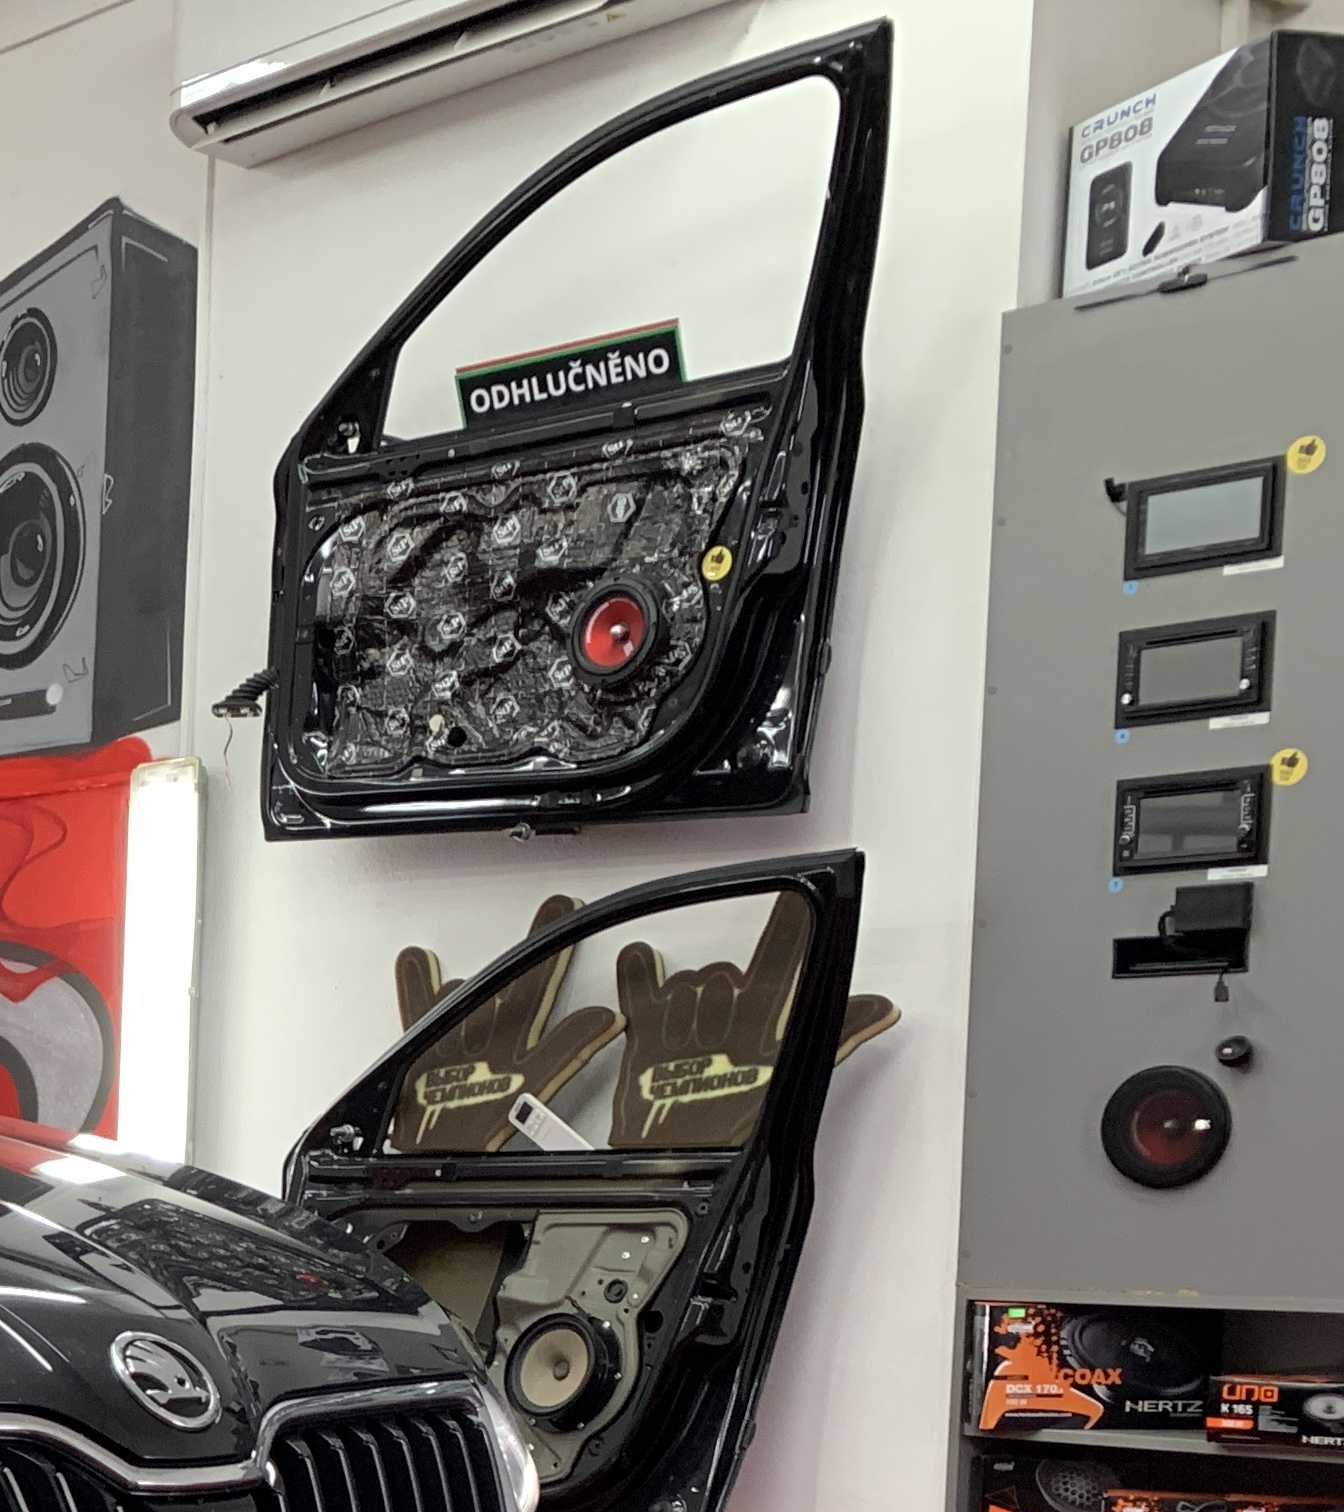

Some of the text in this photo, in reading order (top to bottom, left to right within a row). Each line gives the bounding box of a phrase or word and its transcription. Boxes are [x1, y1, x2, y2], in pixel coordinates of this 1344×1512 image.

[469, 348, 670, 414] ODHLUČNĚNO
[1059, 1367, 1123, 1386] COAX
[1125, 1400, 1203, 1413] HERTZ
[1232, 1403, 1254, 1415] 165
[1301, 1435, 1344, 1447] HERT
